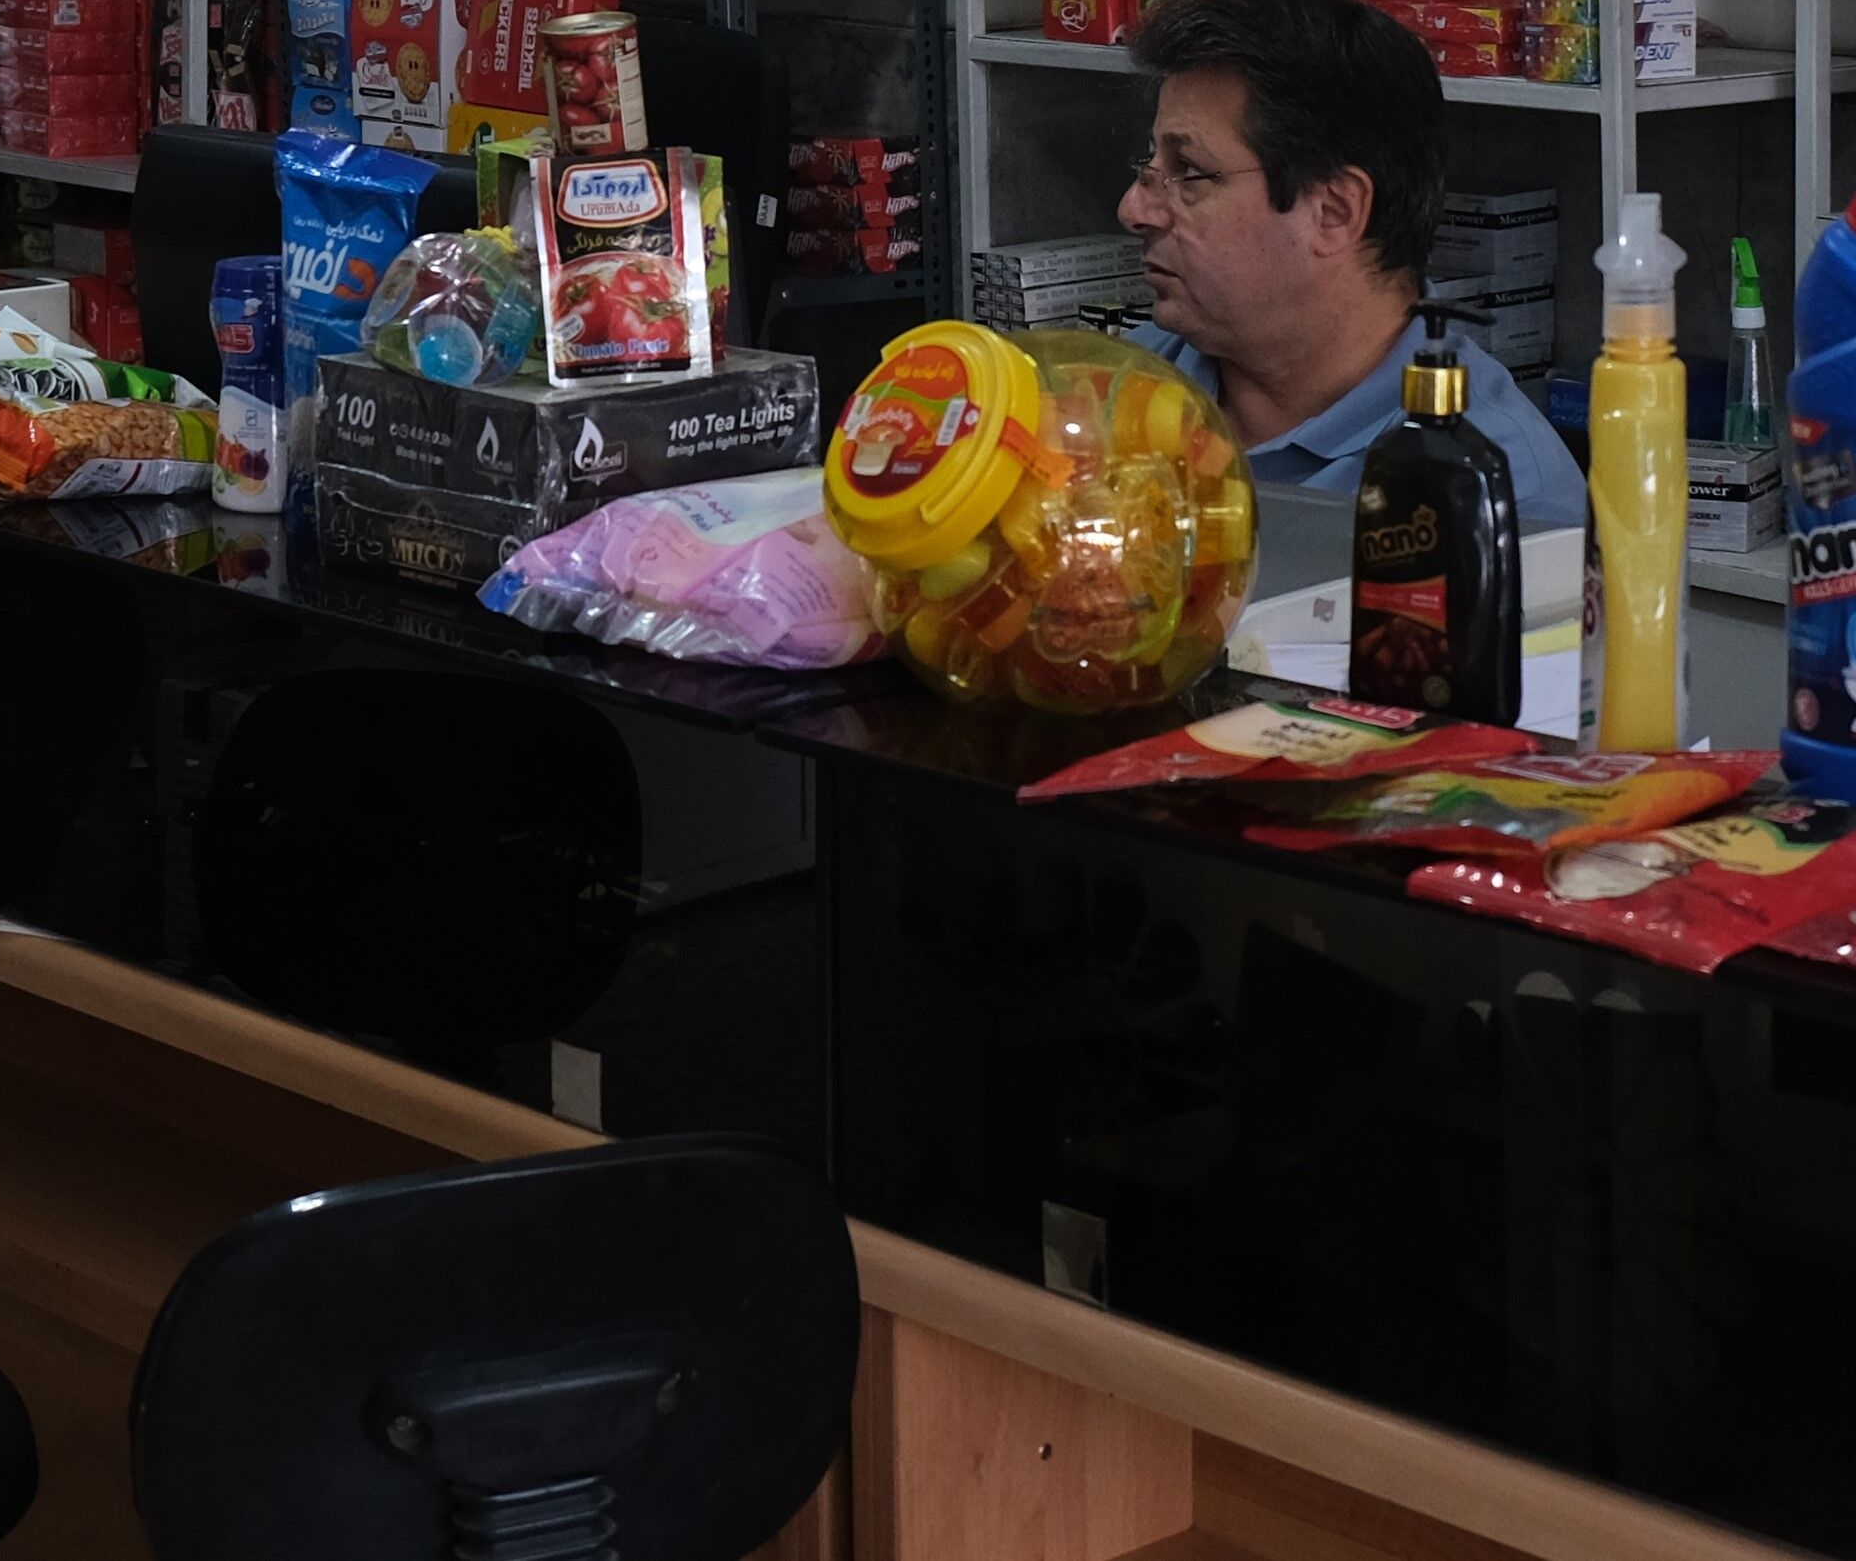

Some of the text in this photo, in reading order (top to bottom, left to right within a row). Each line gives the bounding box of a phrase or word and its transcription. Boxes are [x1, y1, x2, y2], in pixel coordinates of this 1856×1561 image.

[580, 200, 641, 217] UrumAda
[1499, 210, 1556, 226] Micropower
[1494, 289, 1553, 305] Micropower
[335, 394, 377, 430] 100
[669, 403, 796, 441] 100 Tea Lights
[666, 442, 696, 459] Bring
[697, 439, 714, 455] the
[715, 435, 739, 454] light
[753, 431, 774, 448] your
[1363, 524, 1436, 561] nano
